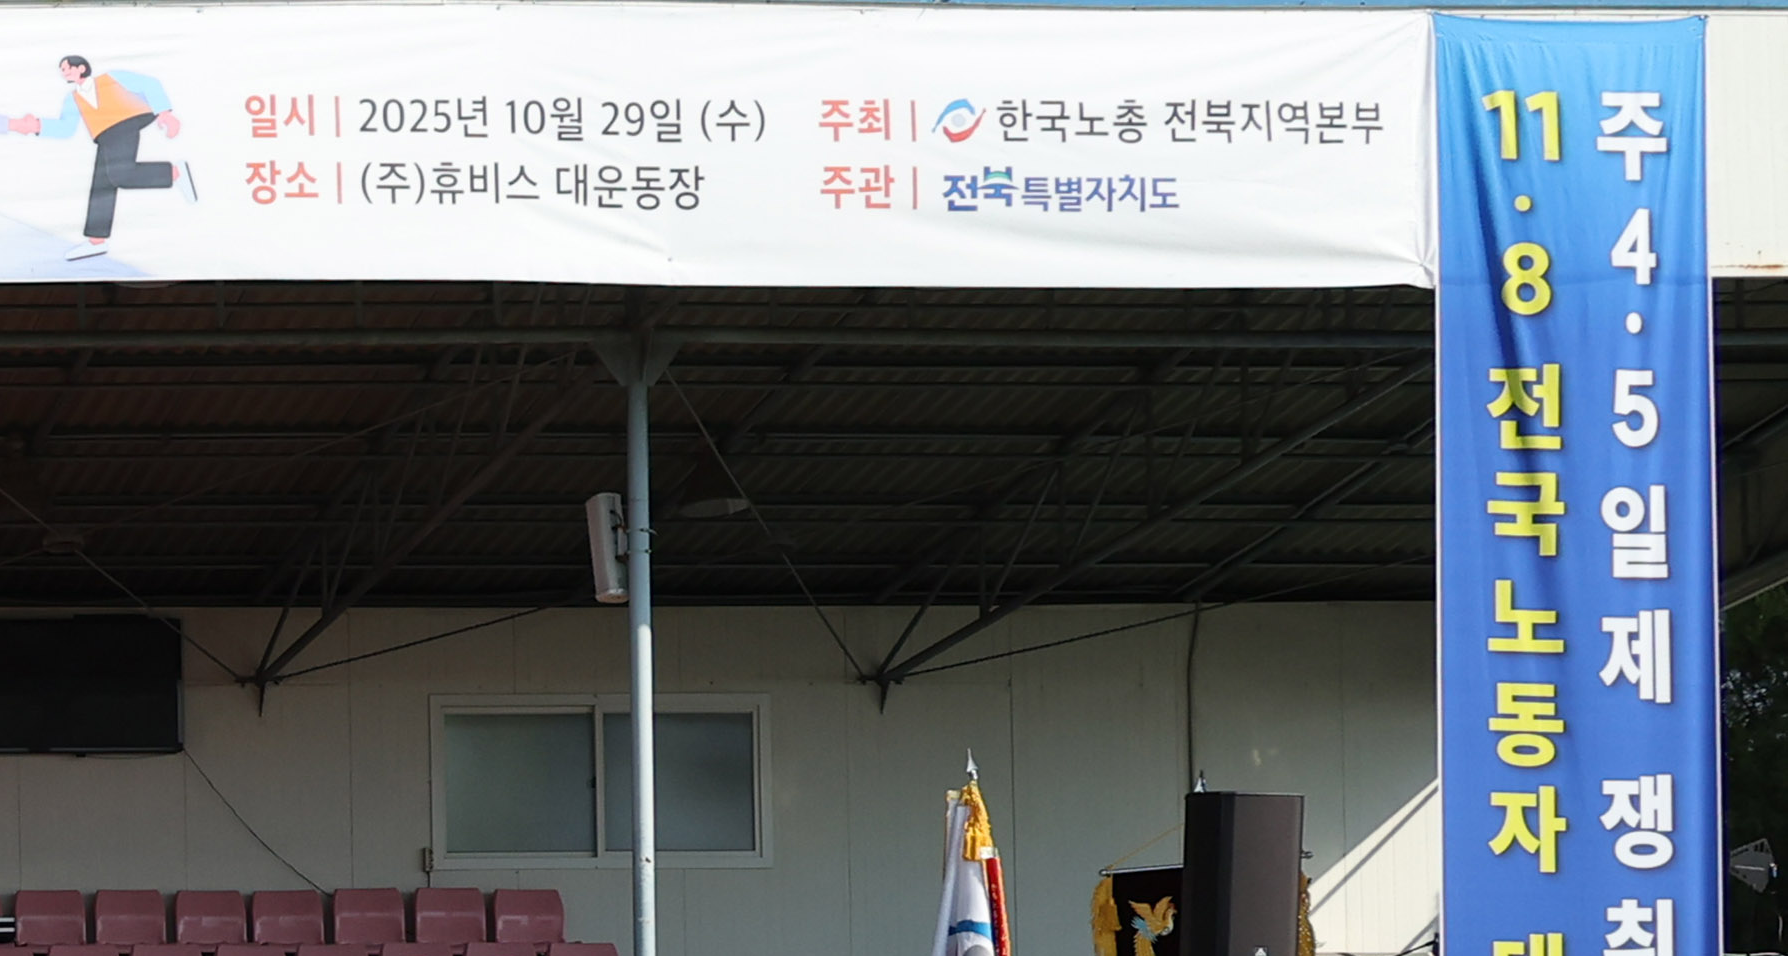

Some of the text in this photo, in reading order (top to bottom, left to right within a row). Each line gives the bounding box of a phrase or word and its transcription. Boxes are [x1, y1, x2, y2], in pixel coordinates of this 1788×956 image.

[244, 94, 767, 143] 일시 2025년 10월 29일 (수)
[819, 99, 1385, 145] 주최 한국노총 전북지역본부
[244, 159, 706, 211] 장소 (주)휴비스 대운동장
[820, 165, 895, 209] 주관
